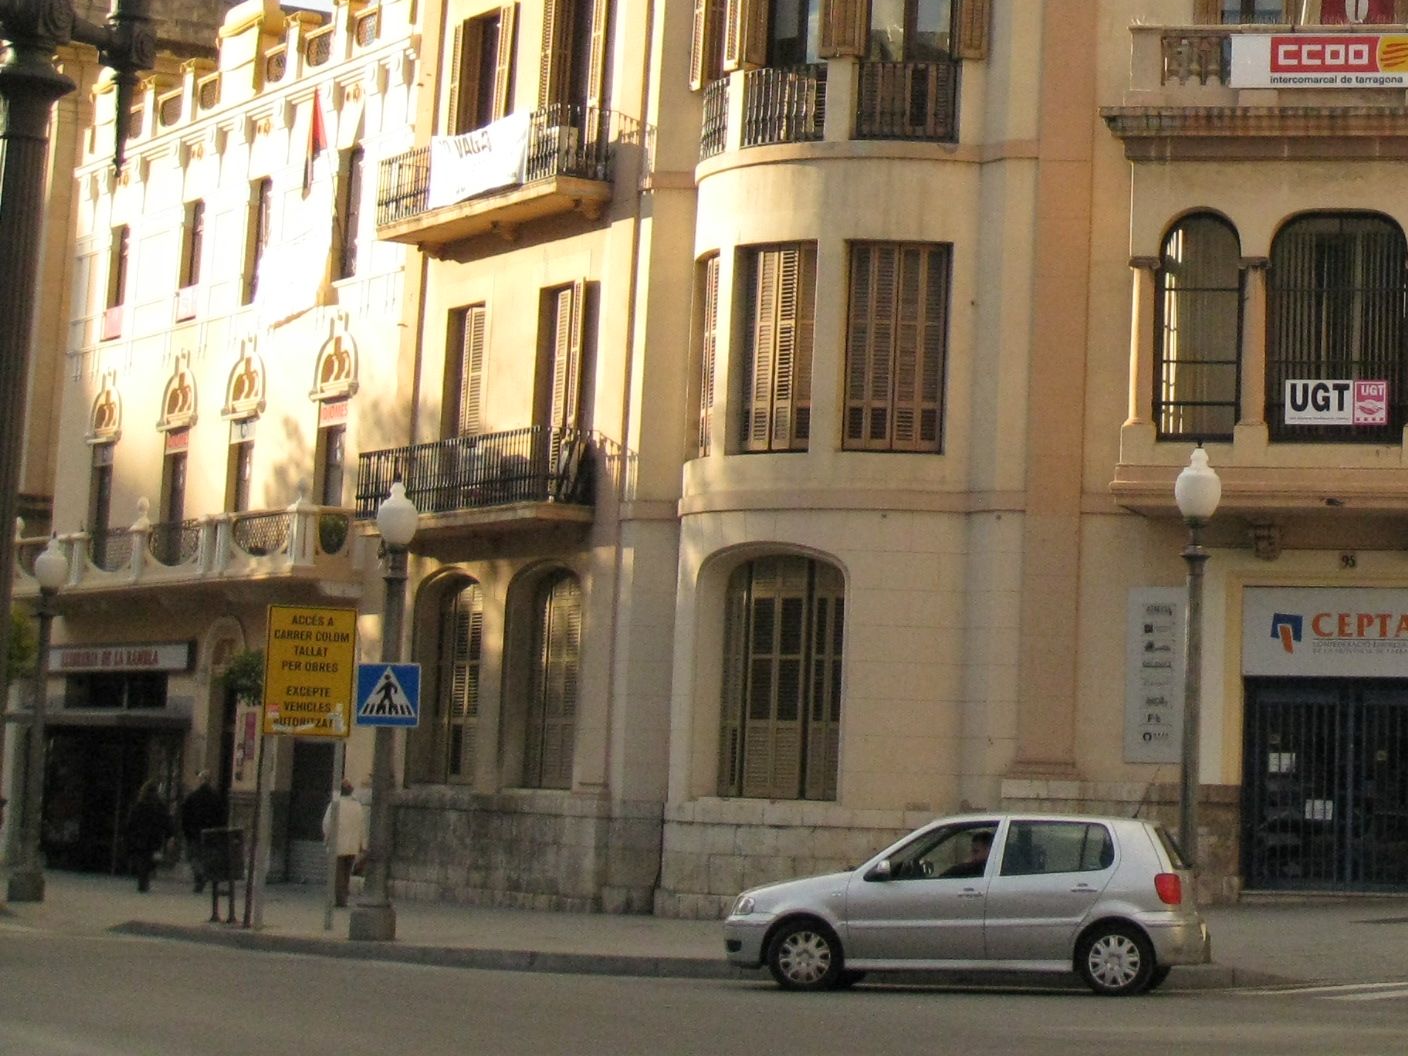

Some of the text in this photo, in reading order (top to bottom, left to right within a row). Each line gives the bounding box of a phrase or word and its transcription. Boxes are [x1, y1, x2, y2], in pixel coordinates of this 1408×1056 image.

[1278, 44, 1369, 65] CCOO
[1270, 75, 1404, 86] intercomarcal de tarragona
[1360, 384, 1385, 396] UGT
[1289, 382, 1350, 412] UGT
[1341, 554, 1356, 570] 95
[327, 616, 334, 627] A
[274, 629, 350, 643] CARRER COLOM
[294, 645, 328, 657] TALLAT
[281, 660, 338, 673] PER OBRES
[286, 686, 332, 697] EXCEPTE
[283, 701, 332, 713] VEHICLES
